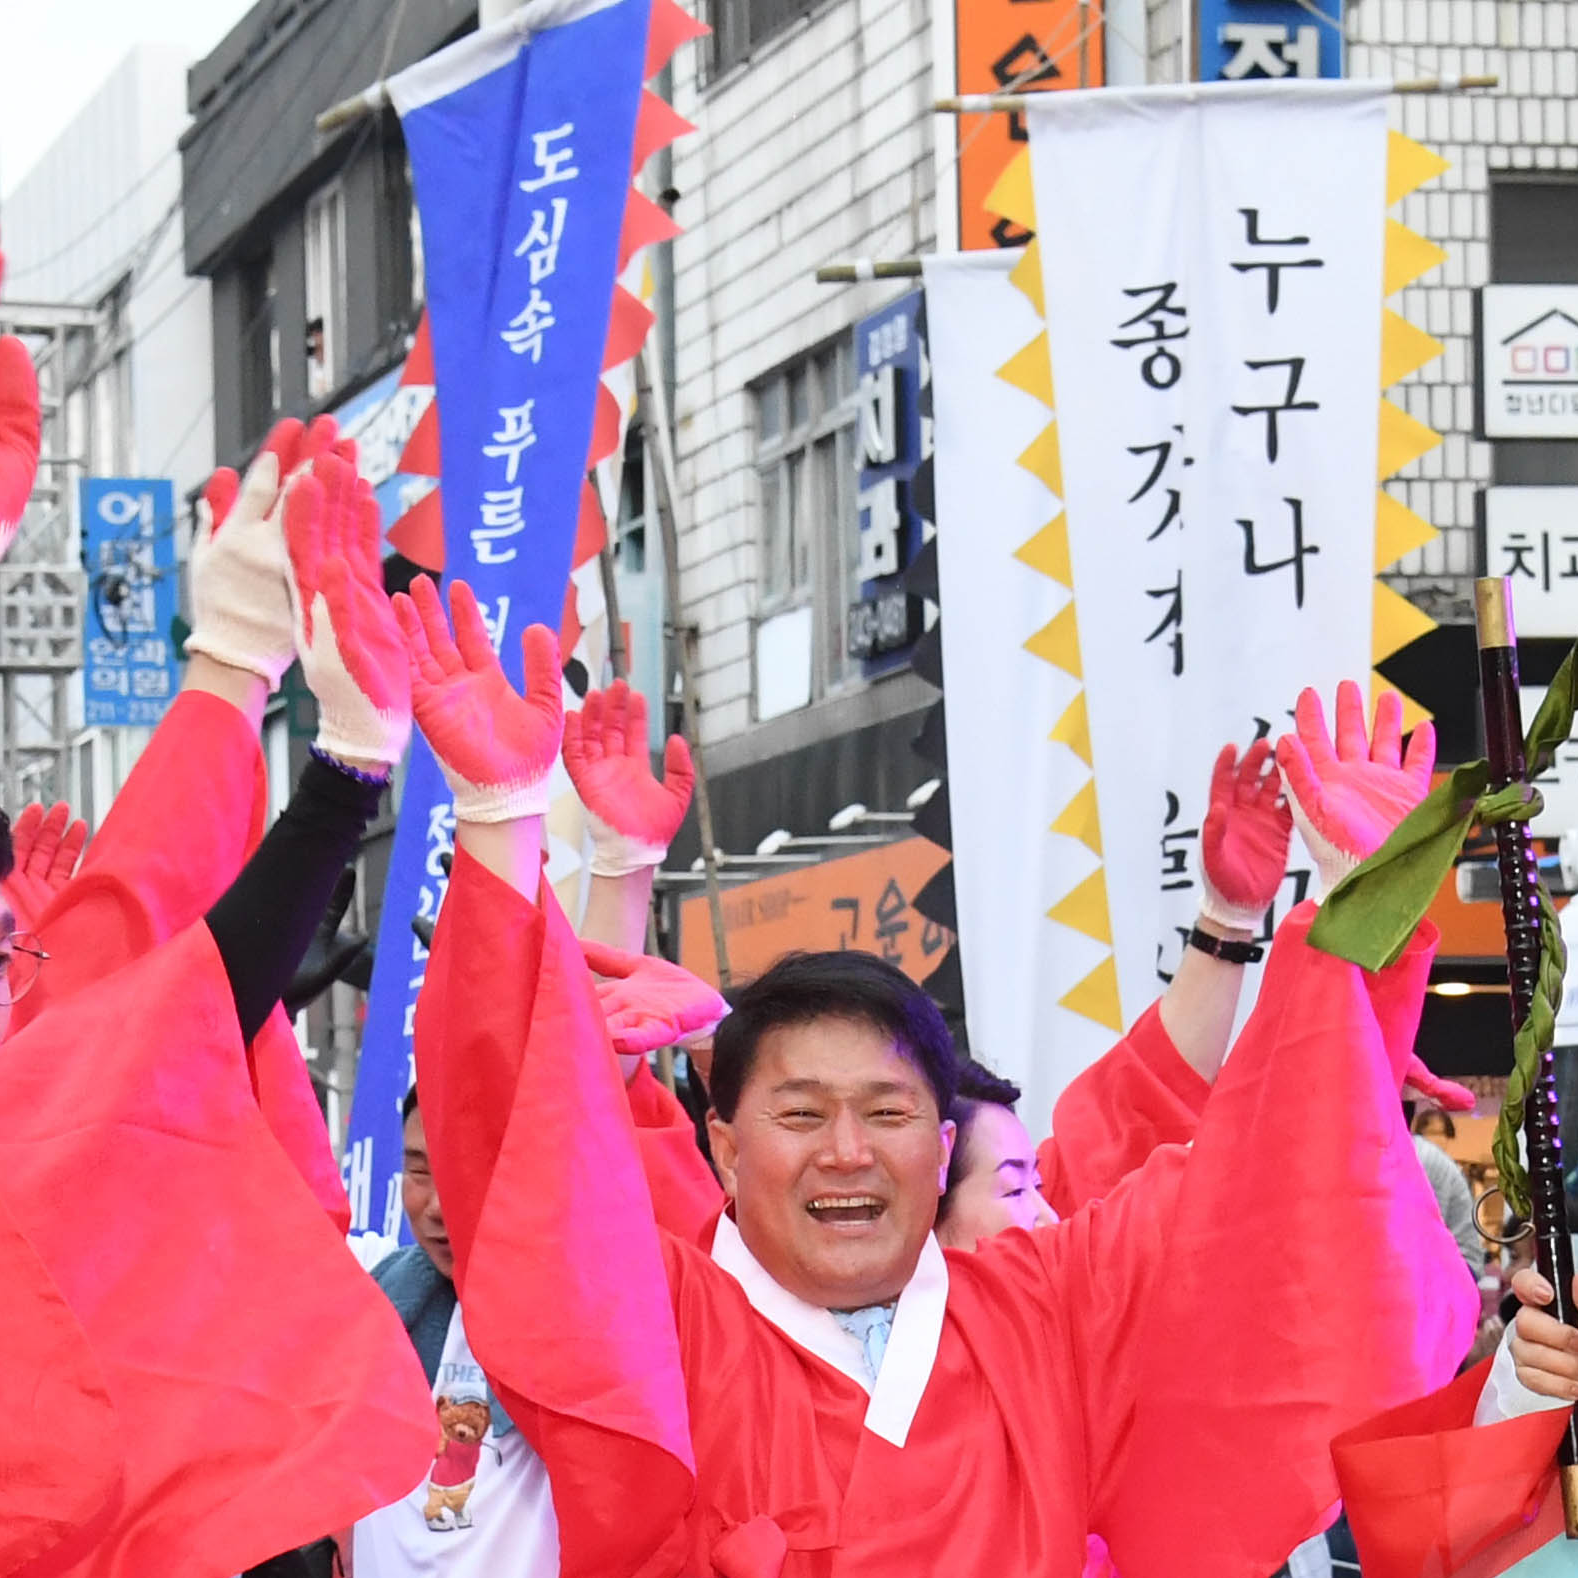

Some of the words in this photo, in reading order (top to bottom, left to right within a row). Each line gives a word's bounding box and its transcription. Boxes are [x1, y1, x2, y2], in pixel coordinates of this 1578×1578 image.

[501, 122, 580, 364] 도심속
[469, 398, 538, 565] 푸른
[1229, 206, 1325, 610] 누구나
